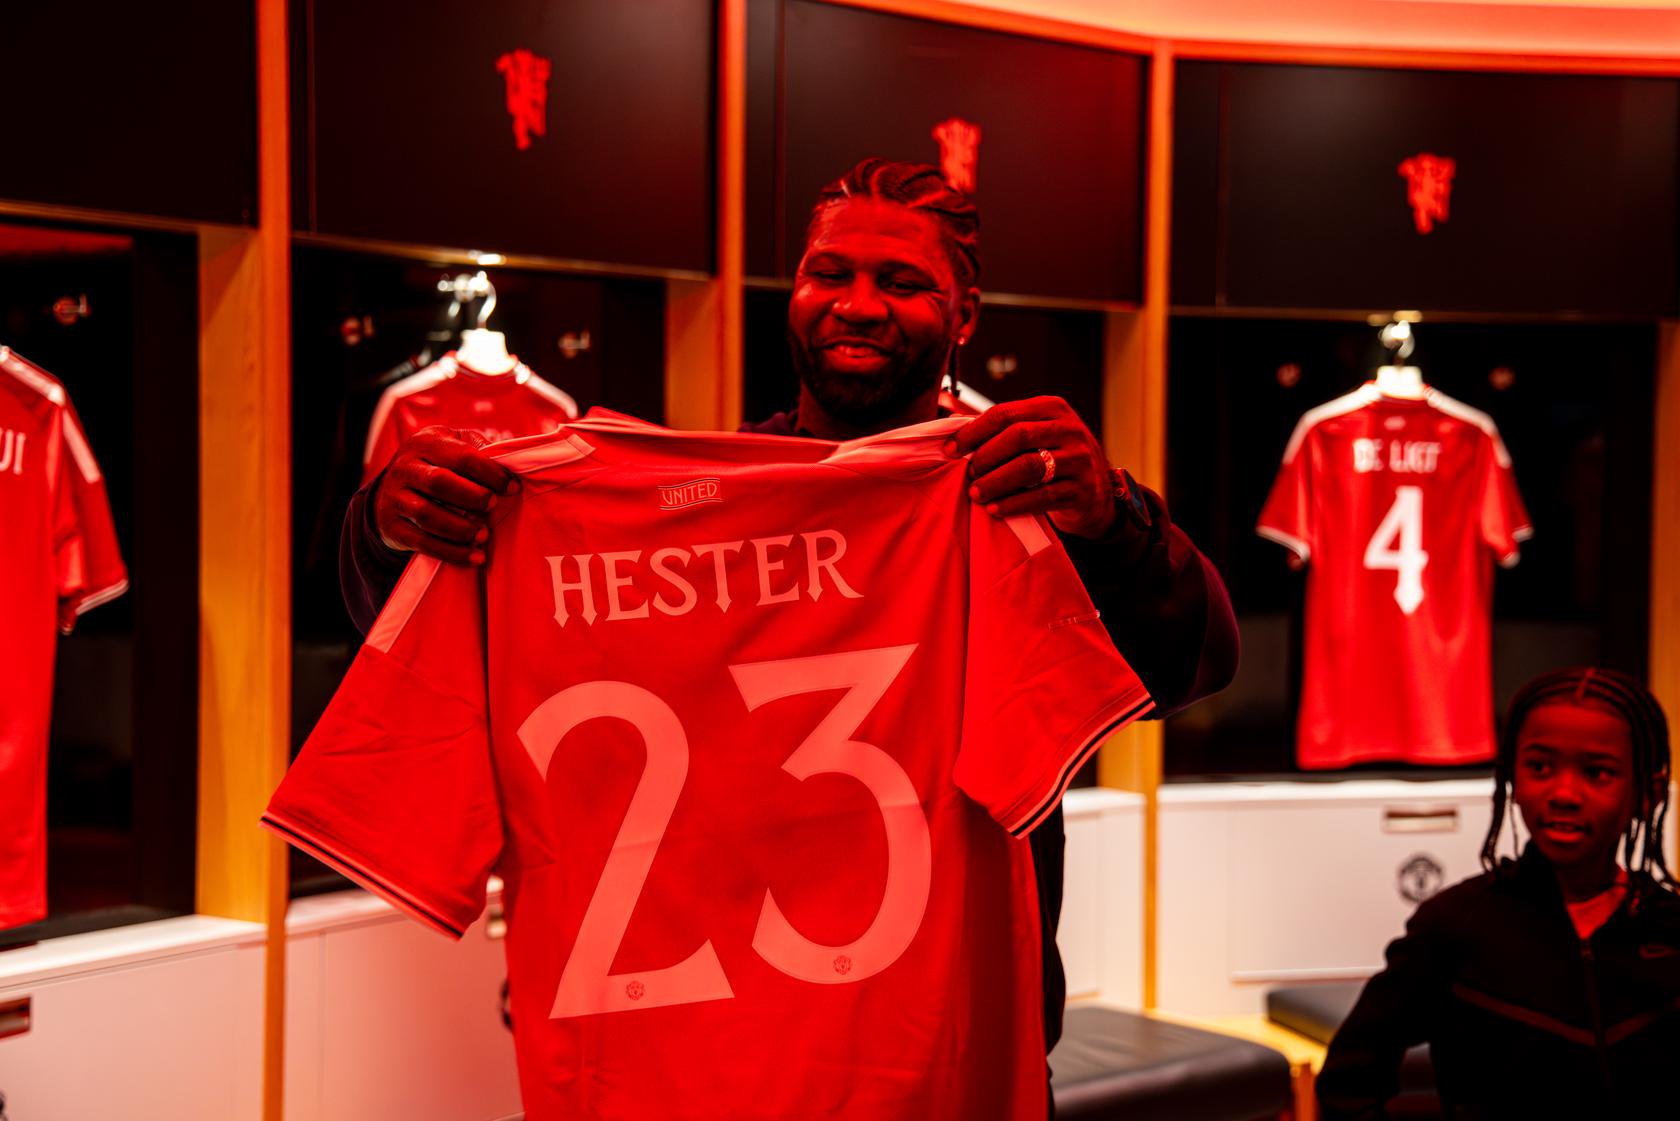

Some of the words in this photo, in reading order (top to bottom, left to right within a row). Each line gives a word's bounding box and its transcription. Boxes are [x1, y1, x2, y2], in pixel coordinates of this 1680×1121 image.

[660, 479, 718, 508] UNITED
[1353, 438, 1384, 473] DE
[545, 529, 865, 629] HESTER
[1363, 485, 1430, 614] 4
[516, 643, 931, 1019] 23
